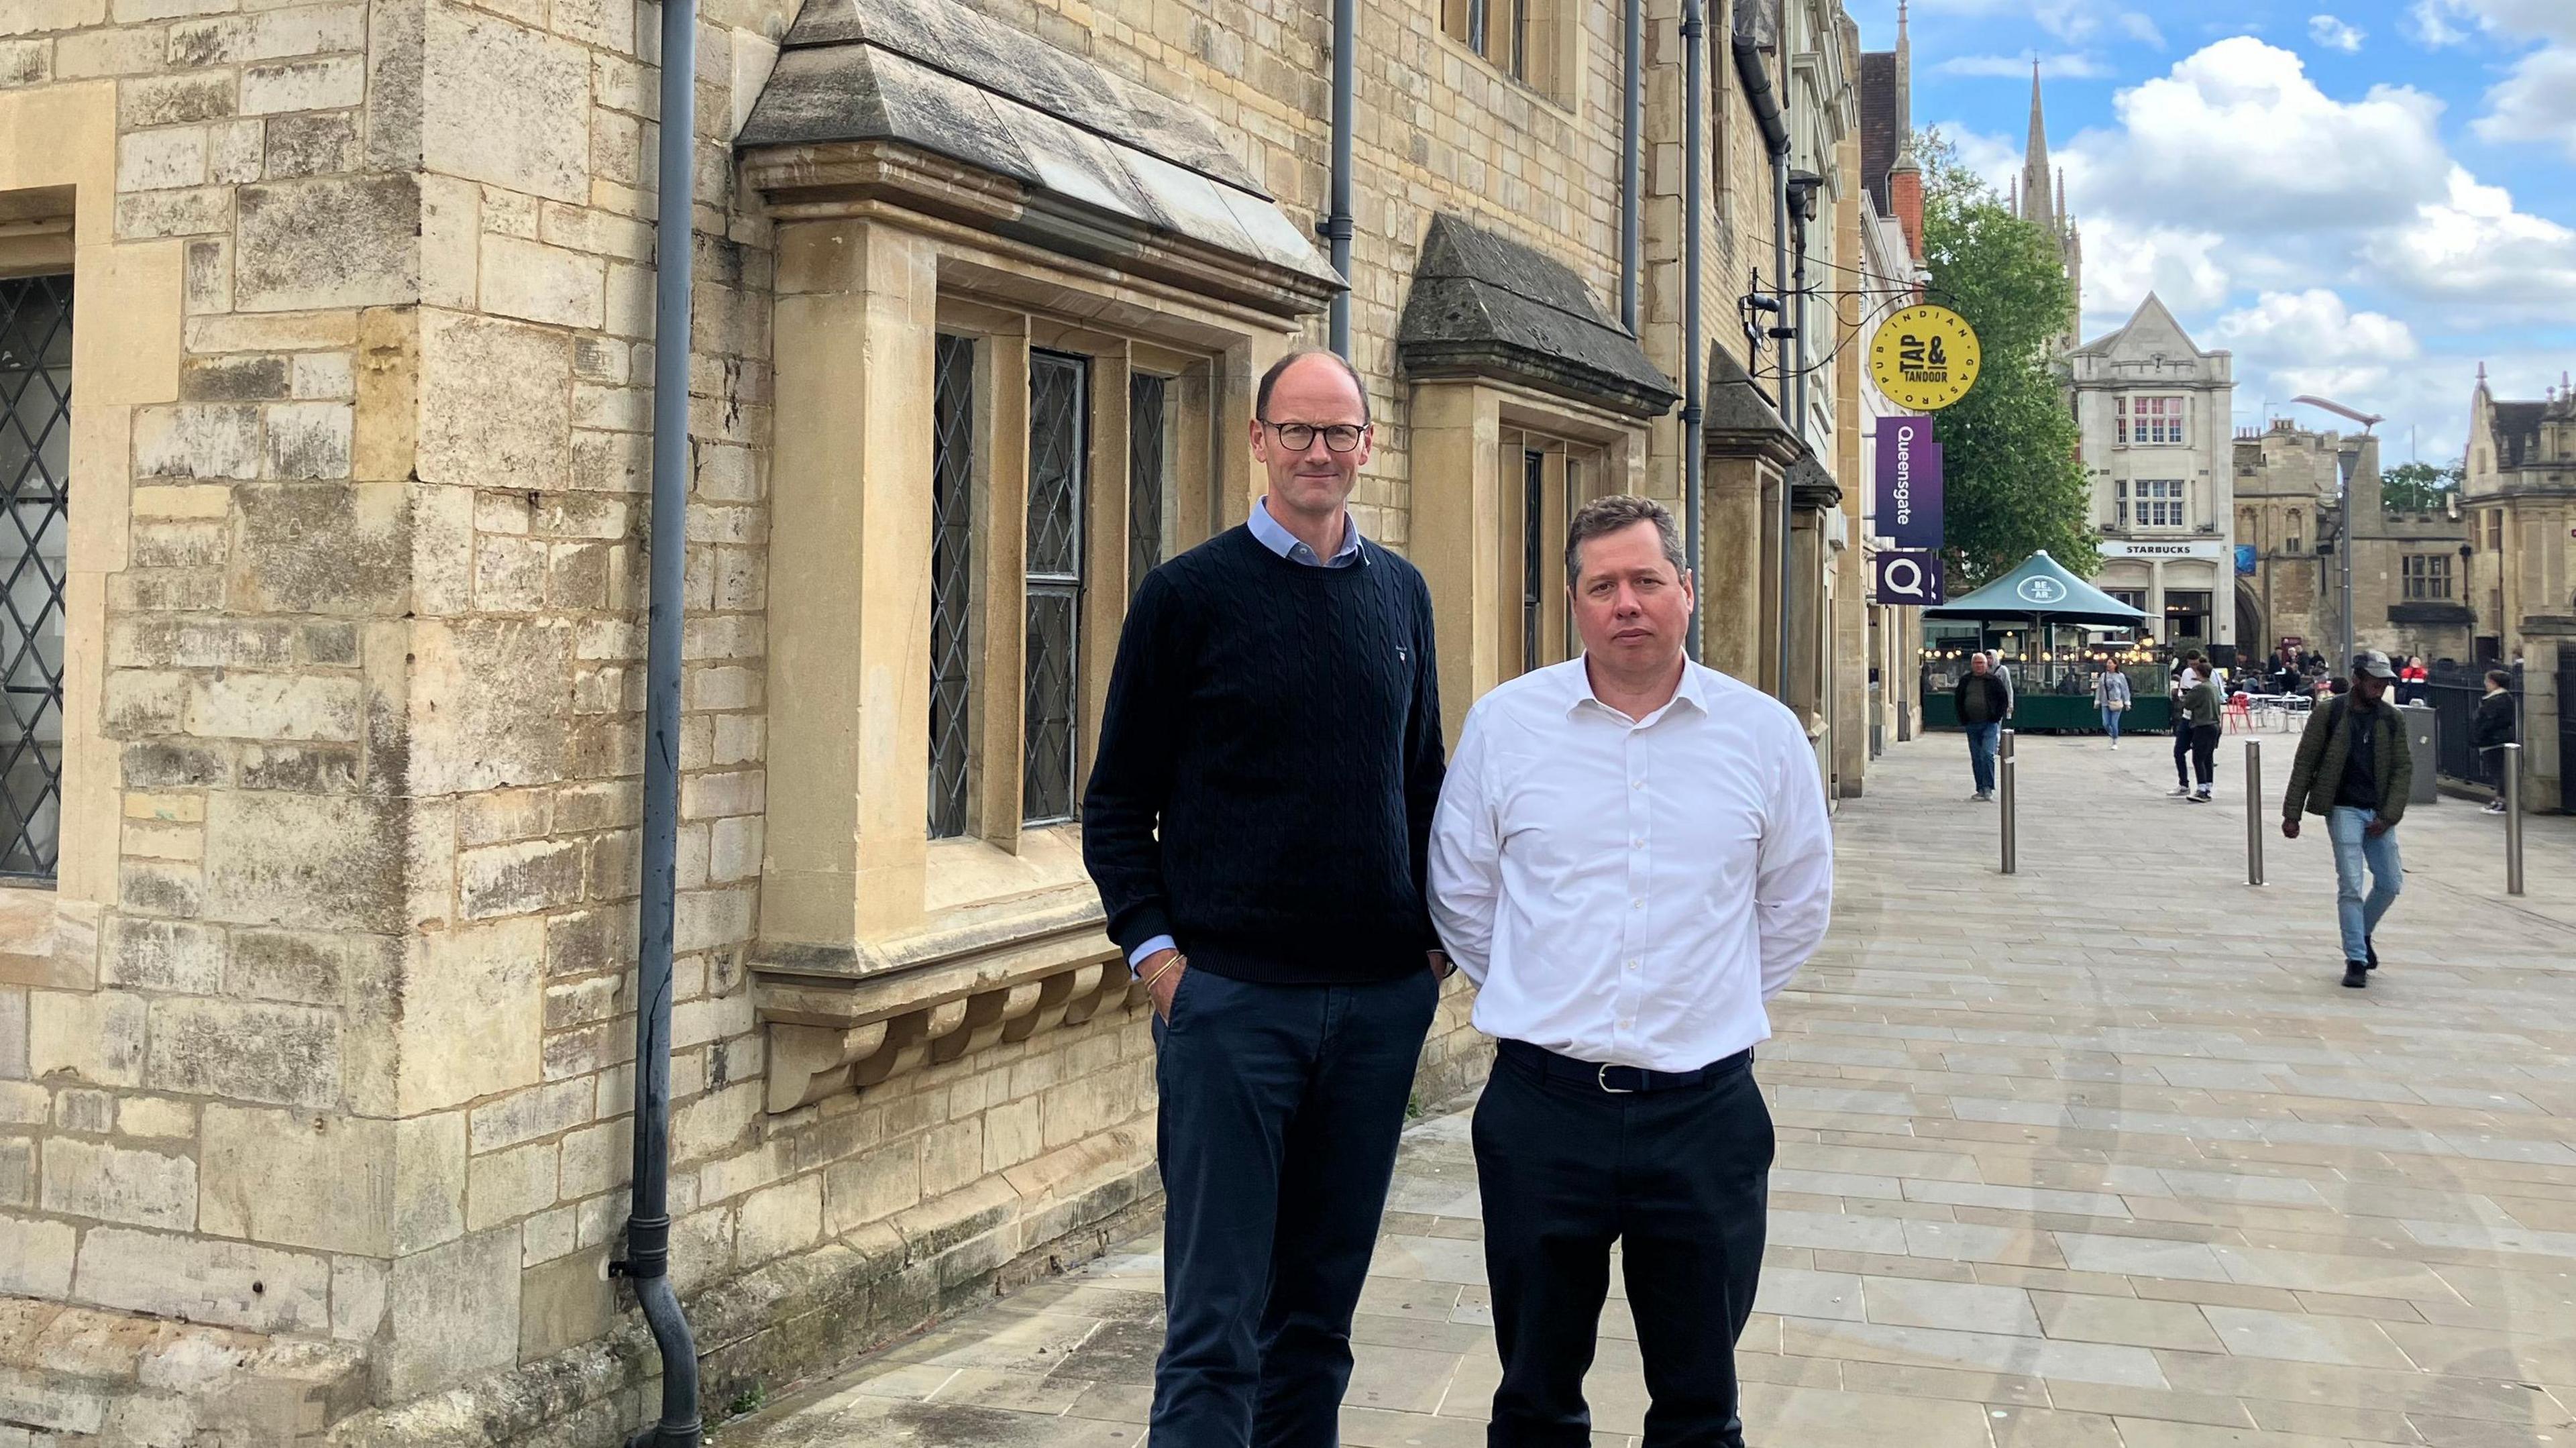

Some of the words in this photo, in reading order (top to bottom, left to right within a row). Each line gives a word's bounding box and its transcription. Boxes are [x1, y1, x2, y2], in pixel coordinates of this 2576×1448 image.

[1892, 311, 1967, 337] INDIAN
[1876, 346, 1889, 383] PUB
[1900, 335, 1925, 372] TAP
[1928, 336, 1946, 365] &
[1904, 371, 1947, 382] TANDOOR
[1905, 359, 1974, 404] GASTRO
[1893, 426, 1913, 525] Queensgate
